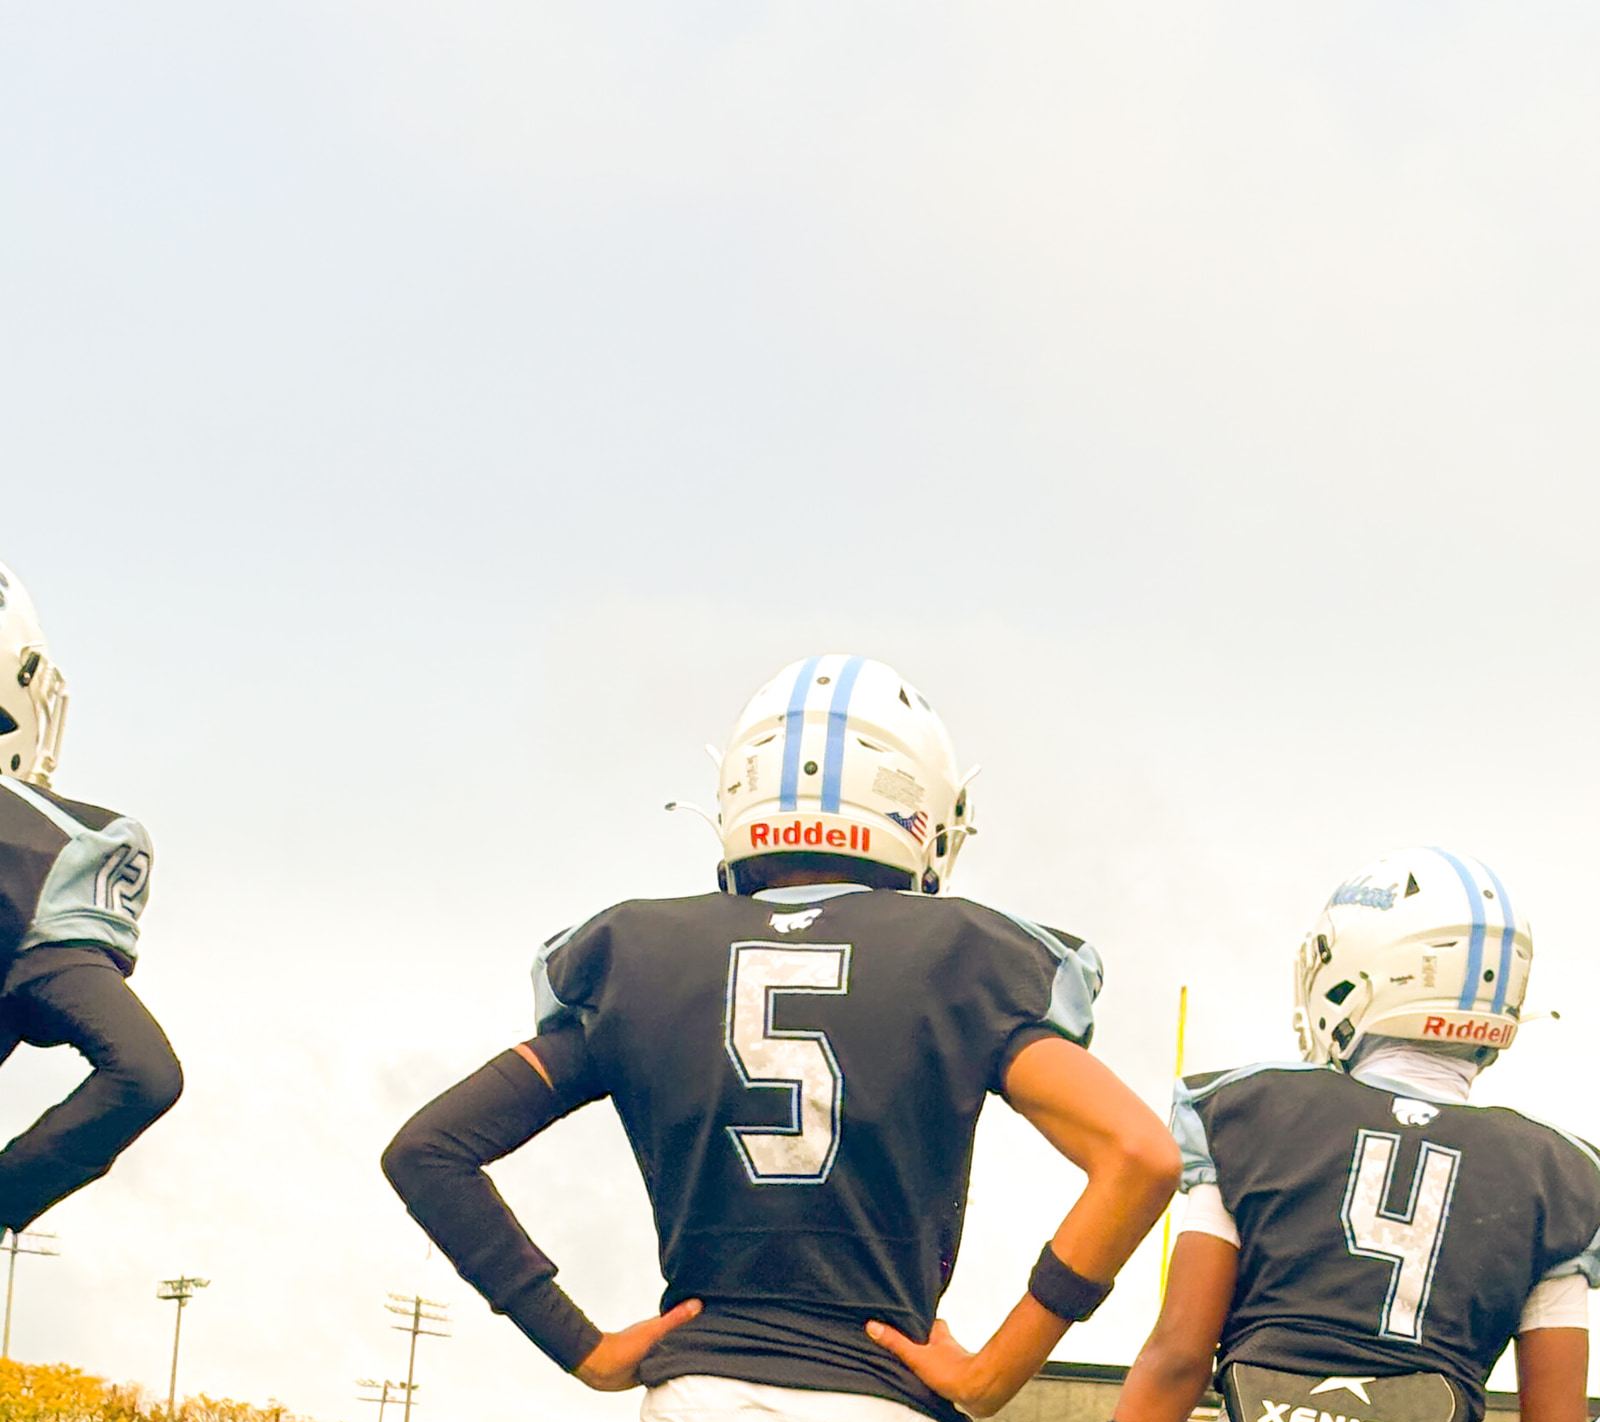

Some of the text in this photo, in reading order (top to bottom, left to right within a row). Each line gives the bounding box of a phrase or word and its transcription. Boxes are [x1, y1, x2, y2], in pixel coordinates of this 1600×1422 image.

[750, 820, 870, 852] Riddell
[94, 844, 150, 920] 12
[725, 939, 852, 1184] 5
[1424, 1015, 1513, 1043] Riddell
[1340, 1129, 1461, 1344] 4
